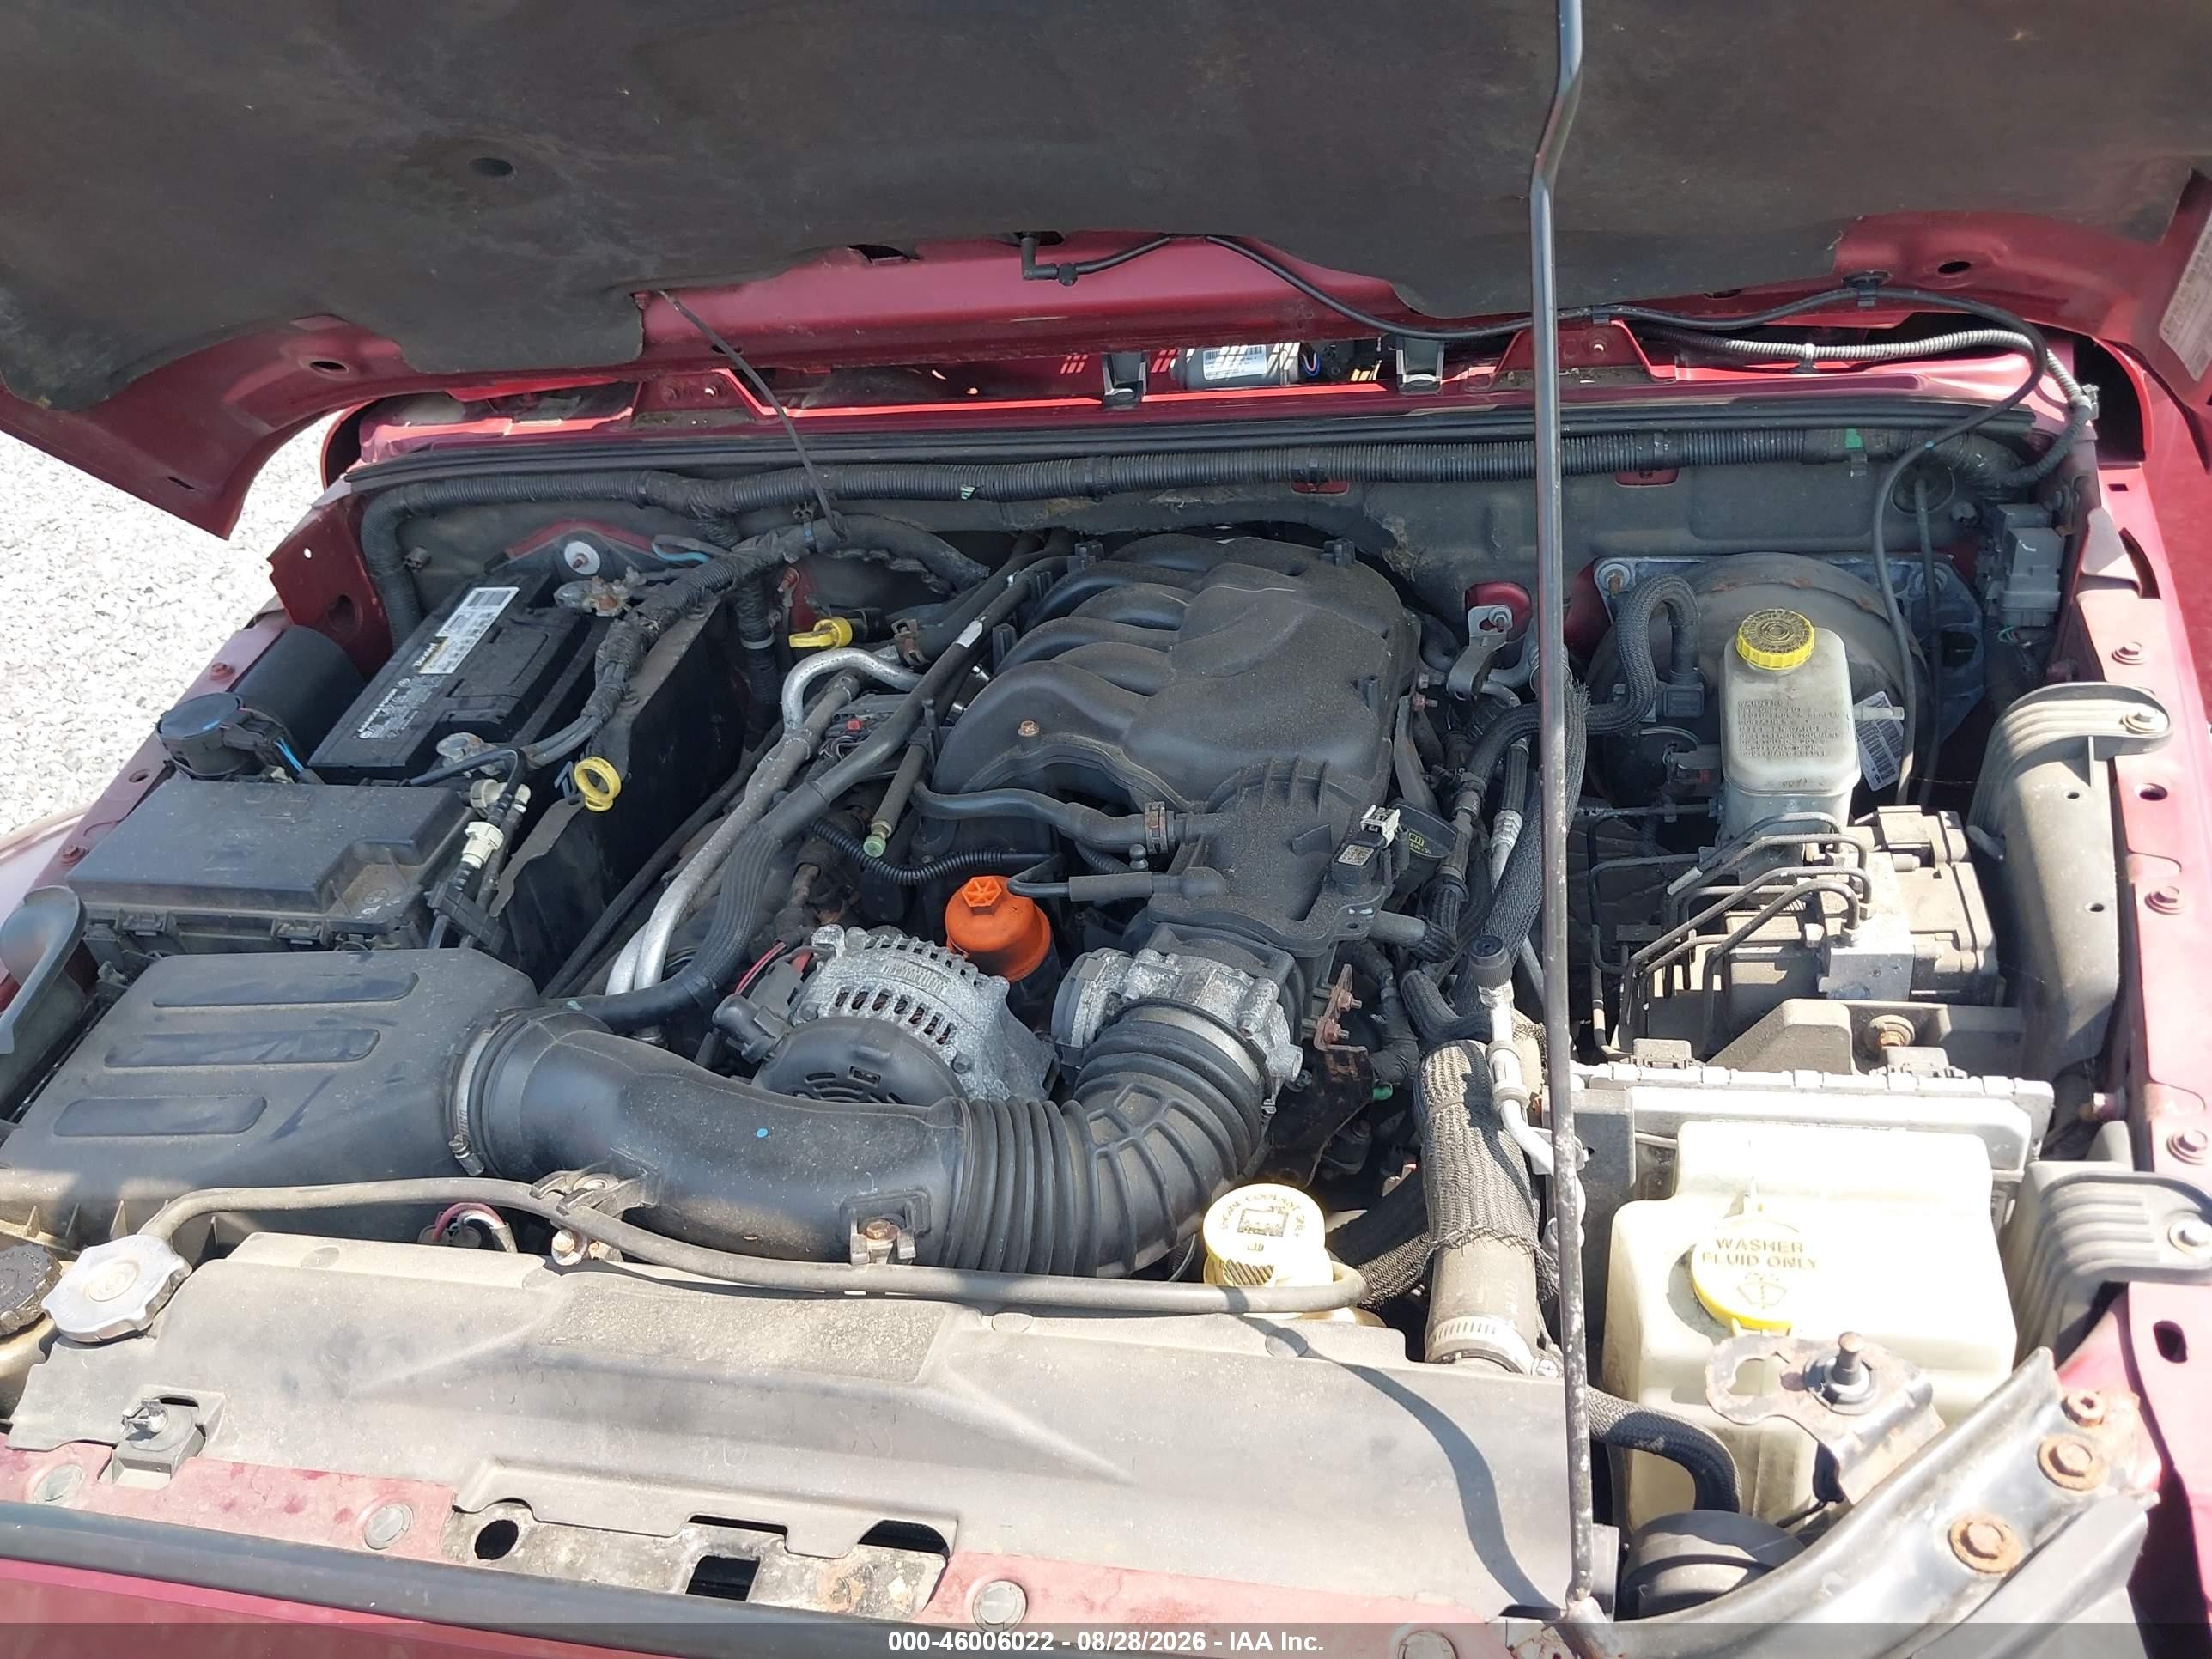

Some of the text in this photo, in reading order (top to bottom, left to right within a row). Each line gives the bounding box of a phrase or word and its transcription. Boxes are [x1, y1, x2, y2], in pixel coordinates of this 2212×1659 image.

[1245, 1194, 1301, 1212] COOLANT
[1716, 1237, 1803, 1254] WASHER
[1702, 1252, 1818, 1269] FLUID ONLY
